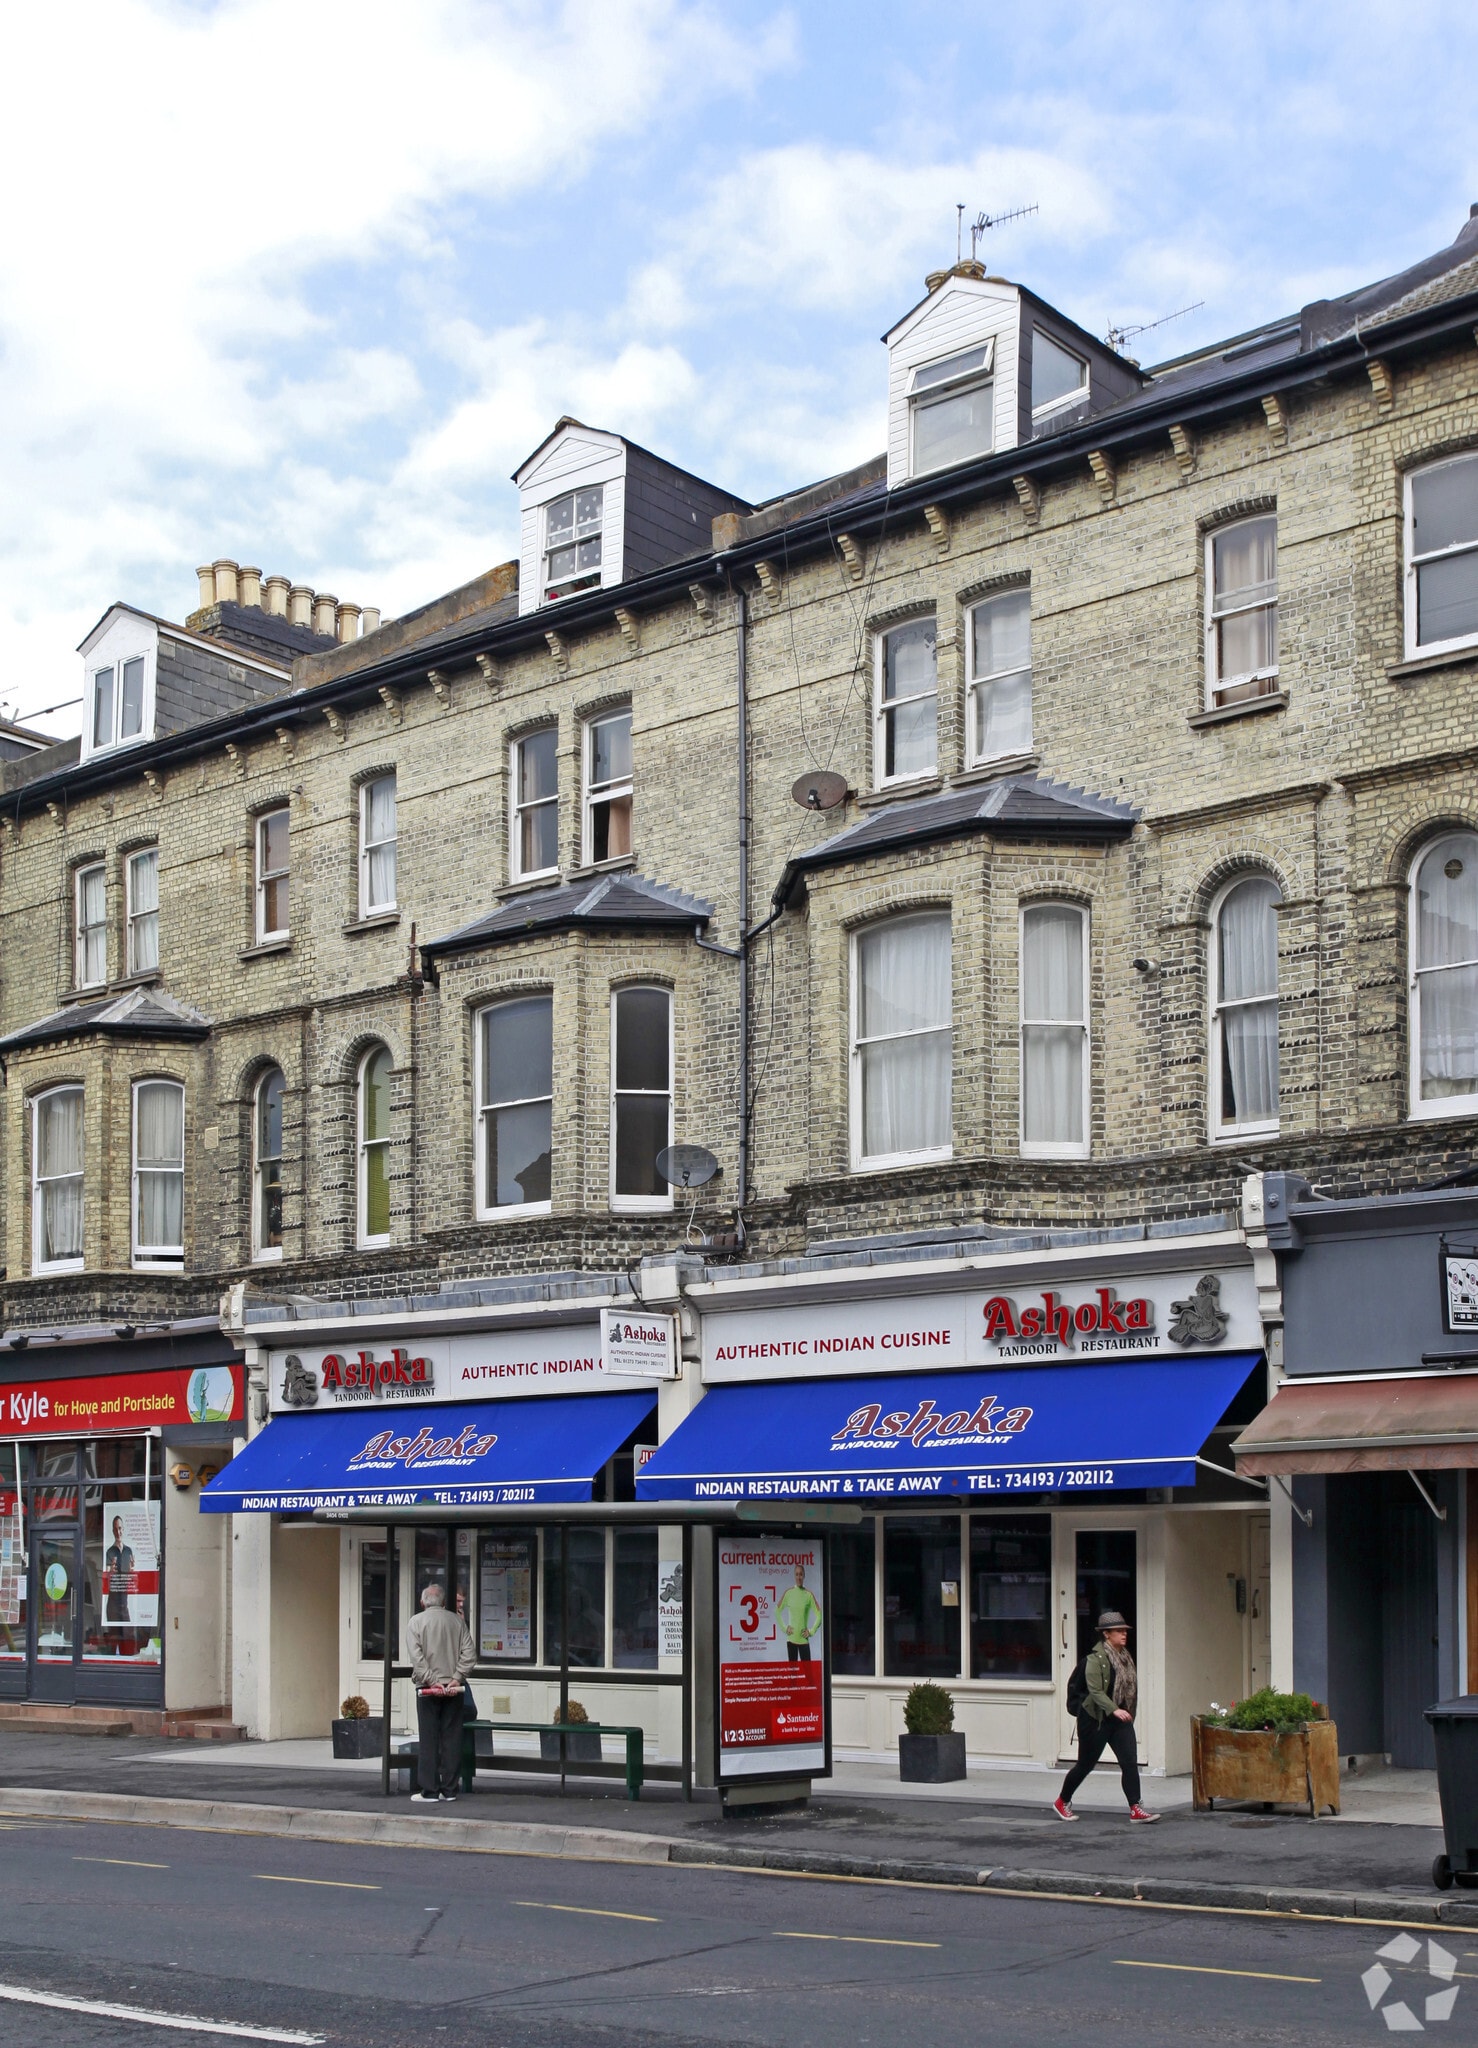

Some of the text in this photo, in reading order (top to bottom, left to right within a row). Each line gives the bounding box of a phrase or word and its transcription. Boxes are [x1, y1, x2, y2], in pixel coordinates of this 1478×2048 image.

[982, 1287, 1152, 1348] Ashoka
[624, 1324, 666, 1345] Ashoka
[715, 1330, 951, 1361] AUTHENTIC INDIAN CUISINE
[998, 1336, 1161, 1357] TANDOORI RESTAURANT
[321, 1348, 430, 1397] Ashoka
[461, 1362, 539, 1381] AUTHENTIC
[543, 1358, 594, 1375] INDIAN
[334, 1387, 437, 1403] TANDOORI RESTAURANT
[10, 1391, 49, 1425] Kyle
[54, 1402, 69, 1417] for
[71, 1400, 99, 1416] Hove
[101, 1397, 121, 1414] and
[123, 1393, 176, 1413] Portslade
[831, 1395, 1034, 1448] Ashoka
[350, 1424, 499, 1468] Ashoka
[830, 1435, 1013, 1451] TANDOORI RESTAURANT
[345, 1458, 477, 1472] TANDOORI RESTAURANT
[695, 1481, 744, 1495] INDIAN
[748, 1479, 840, 1495] RESTAURANT
[843, 1479, 853, 1492] &
[857, 1478, 894, 1492] TAKE
[898, 1476, 942, 1491] AWAY
[967, 1475, 1001, 1489] TEL:
[1005, 1472, 1055, 1488] 734193
[1066, 1470, 1114, 1485] 202112
[242, 1497, 278, 1509] INDIAN
[280, 1495, 346, 1508] RESTAURANT
[347, 1495, 356, 1507] &
[357, 1494, 384, 1505] TAKE
[385, 1493, 418, 1505] AWAY
[434, 1492, 457, 1504] TEL:
[459, 1490, 494, 1503] 734193
[502, 1488, 535, 1501] 202112
[484, 1543, 528, 1553] Bus Information
[721, 1549, 815, 1566] current account
[768, 1567, 781, 1575] gives
[780, 1568, 790, 1576] you
[786, 1712, 819, 1723] Santander
